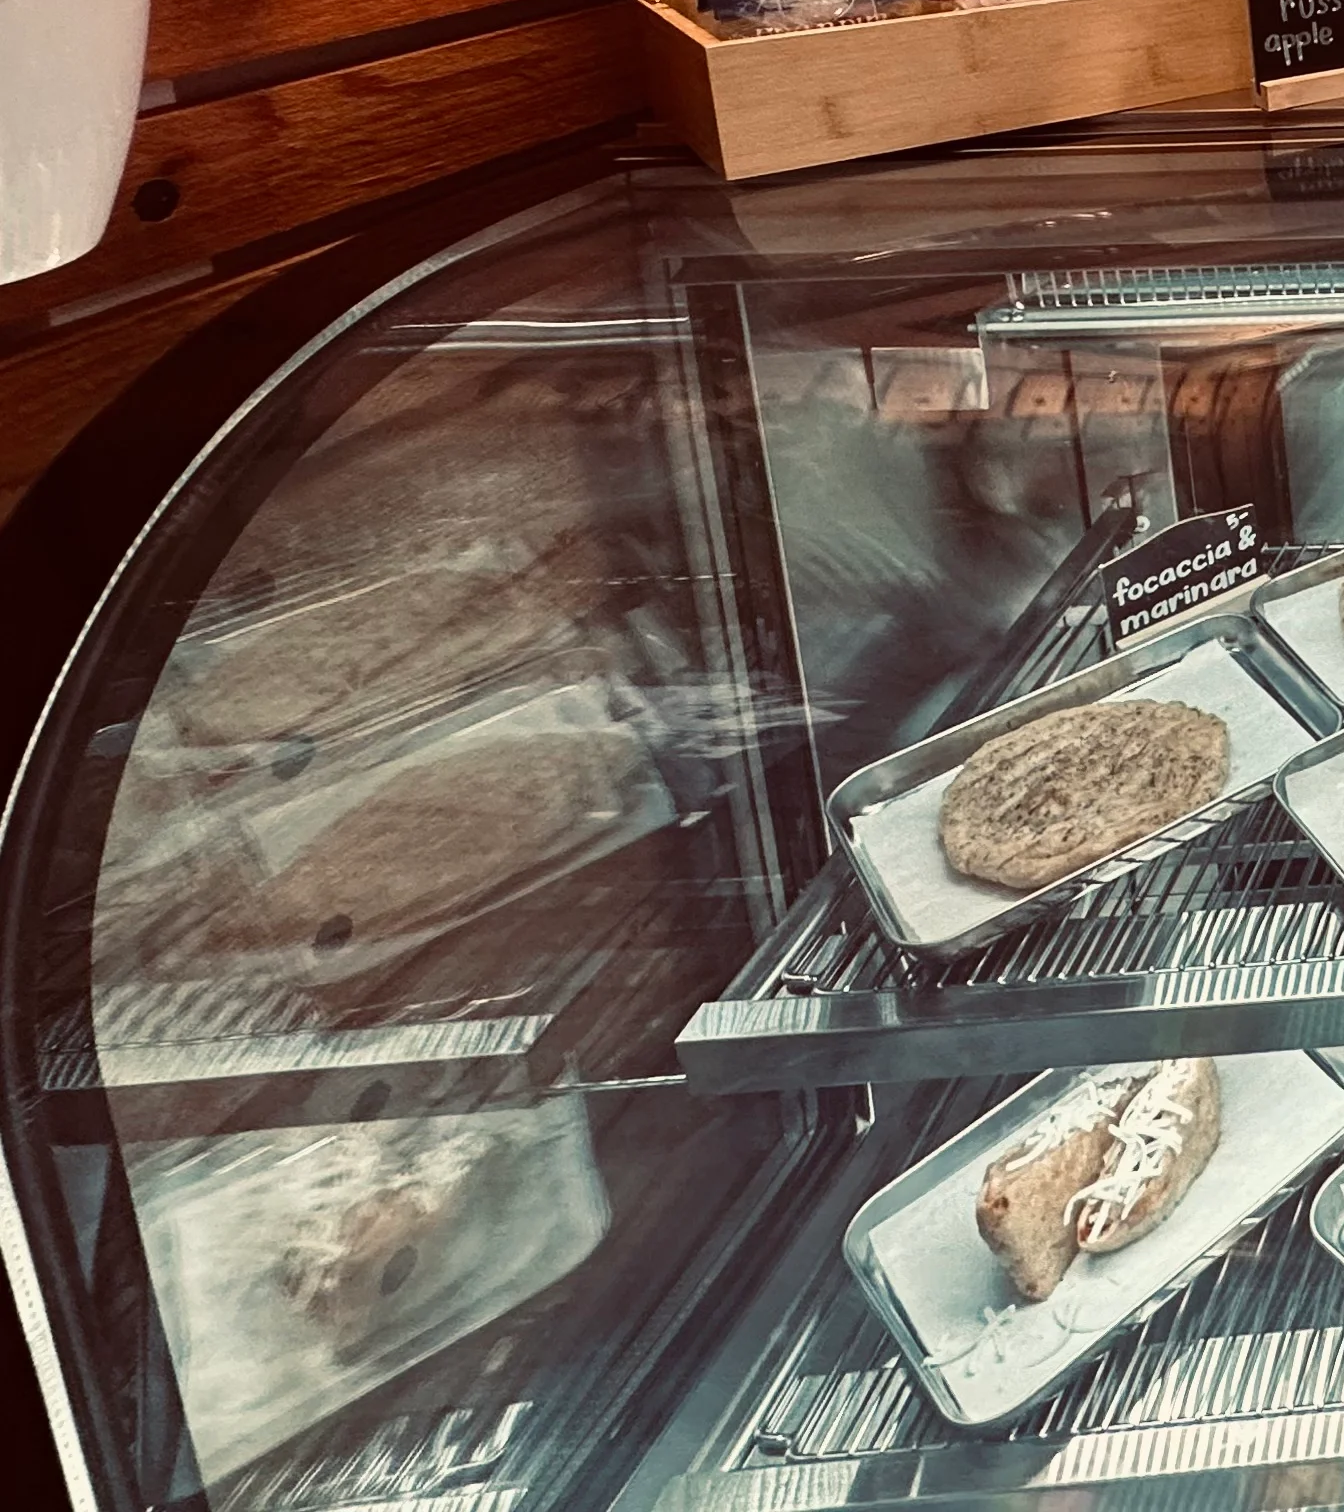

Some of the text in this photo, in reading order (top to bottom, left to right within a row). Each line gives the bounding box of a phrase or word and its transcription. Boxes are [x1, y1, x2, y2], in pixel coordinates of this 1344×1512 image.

[1264, 21, 1334, 66] apple
[1112, 525, 1257, 607] focaccia &
[1120, 558, 1258, 635] marinara
